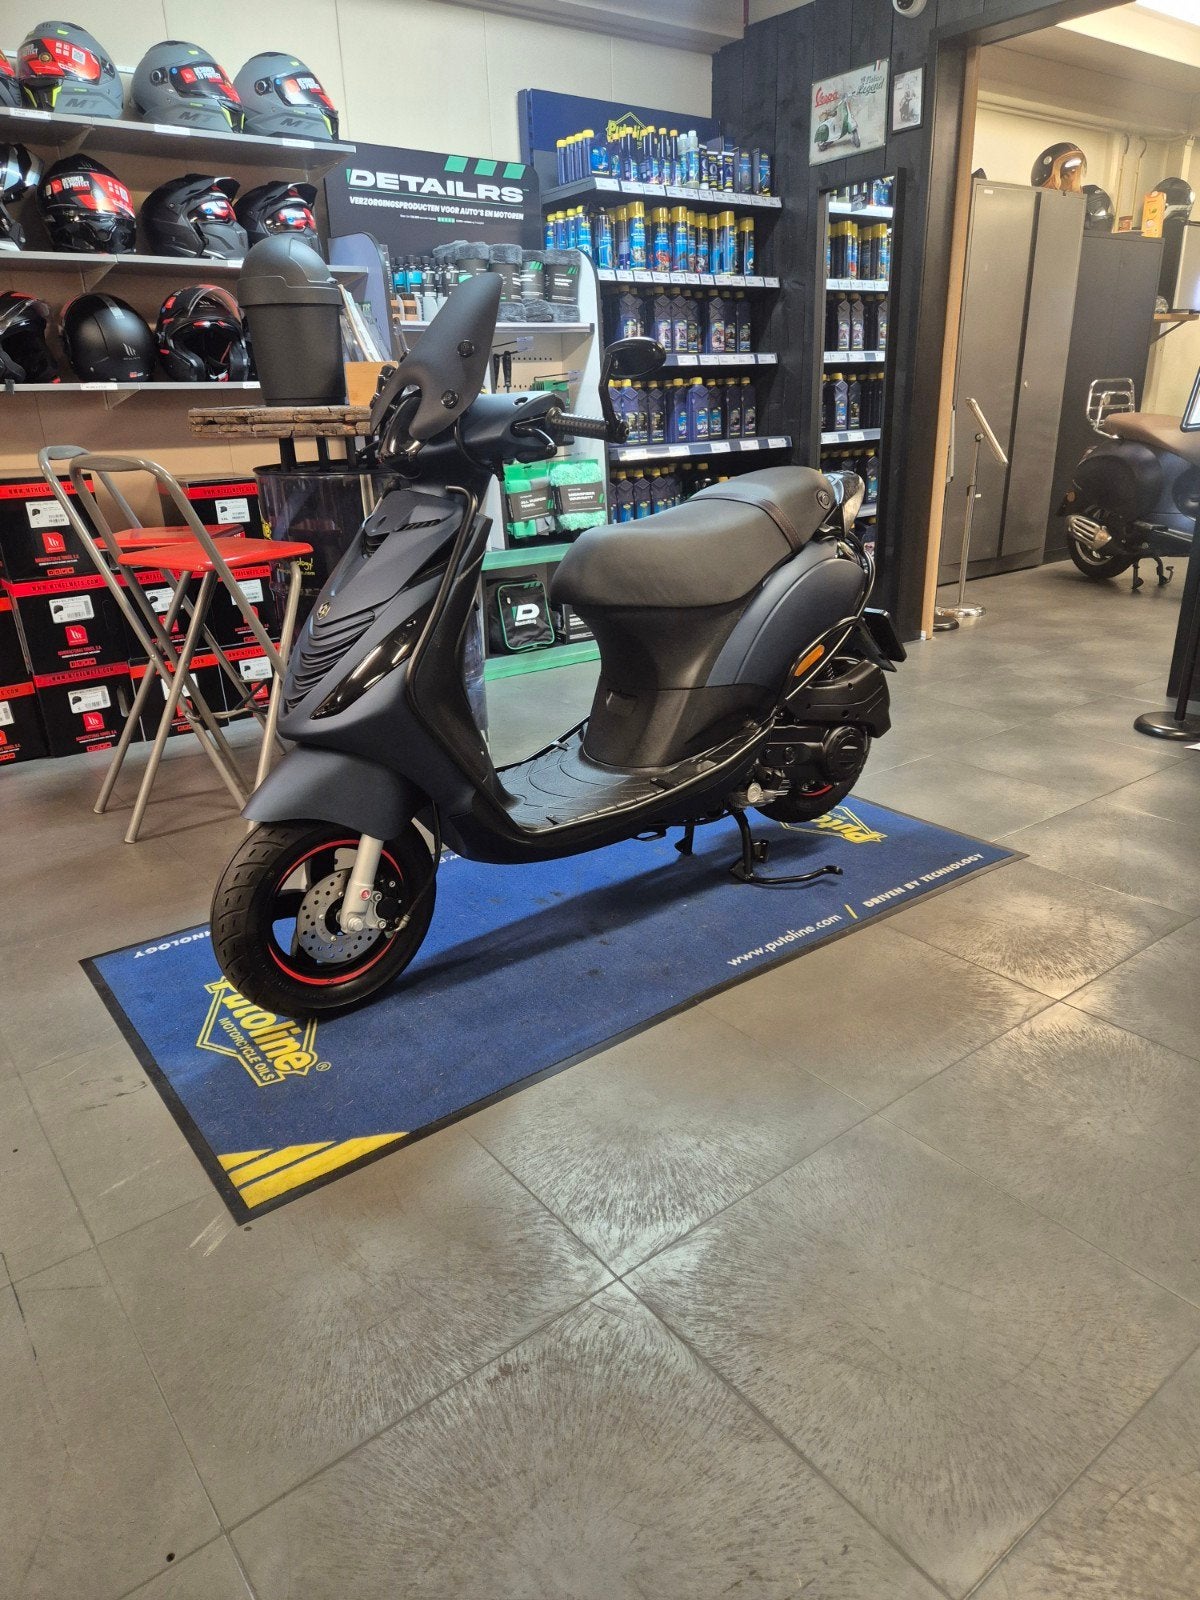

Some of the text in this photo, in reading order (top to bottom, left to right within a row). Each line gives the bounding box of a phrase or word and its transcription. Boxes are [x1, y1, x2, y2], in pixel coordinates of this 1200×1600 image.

[350, 169, 524, 203] DETAILRS
[350, 196, 524, 220] VERZORGINGSPRODUCTEN VOOR AUTO'S EN MOTOREN
[862, 853, 984, 908] DRIVEN BY TECHNOLOGY
[727, 914, 842, 967] www.putoline.com
[218, 1017, 275, 1081] MOTORCYCLE OILS
